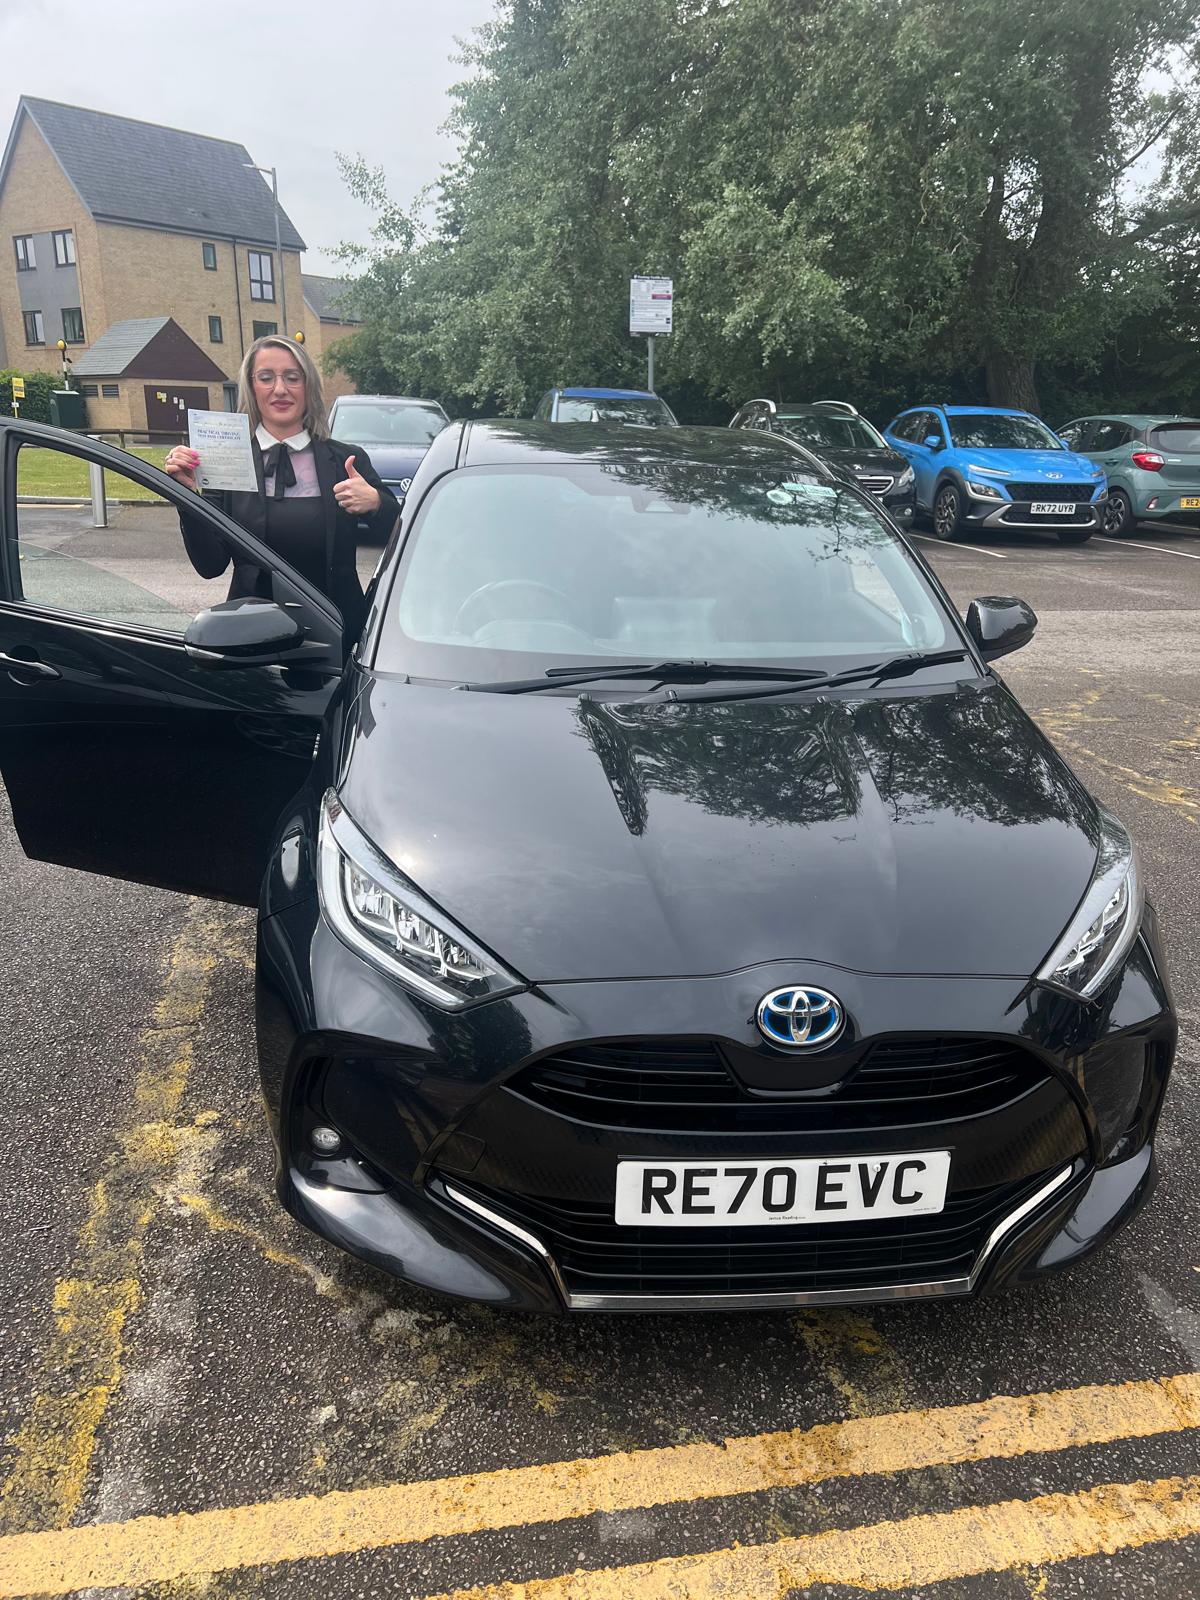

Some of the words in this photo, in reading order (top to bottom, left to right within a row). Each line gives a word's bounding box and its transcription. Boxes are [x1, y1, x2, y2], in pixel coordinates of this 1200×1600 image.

[1185, 498, 1200, 507] RE2
[1035, 504, 1057, 513] RK72
[1058, 504, 1075, 513] UYR
[641, 1166, 797, 1215] RE70
[815, 1160, 927, 1211] EVC
